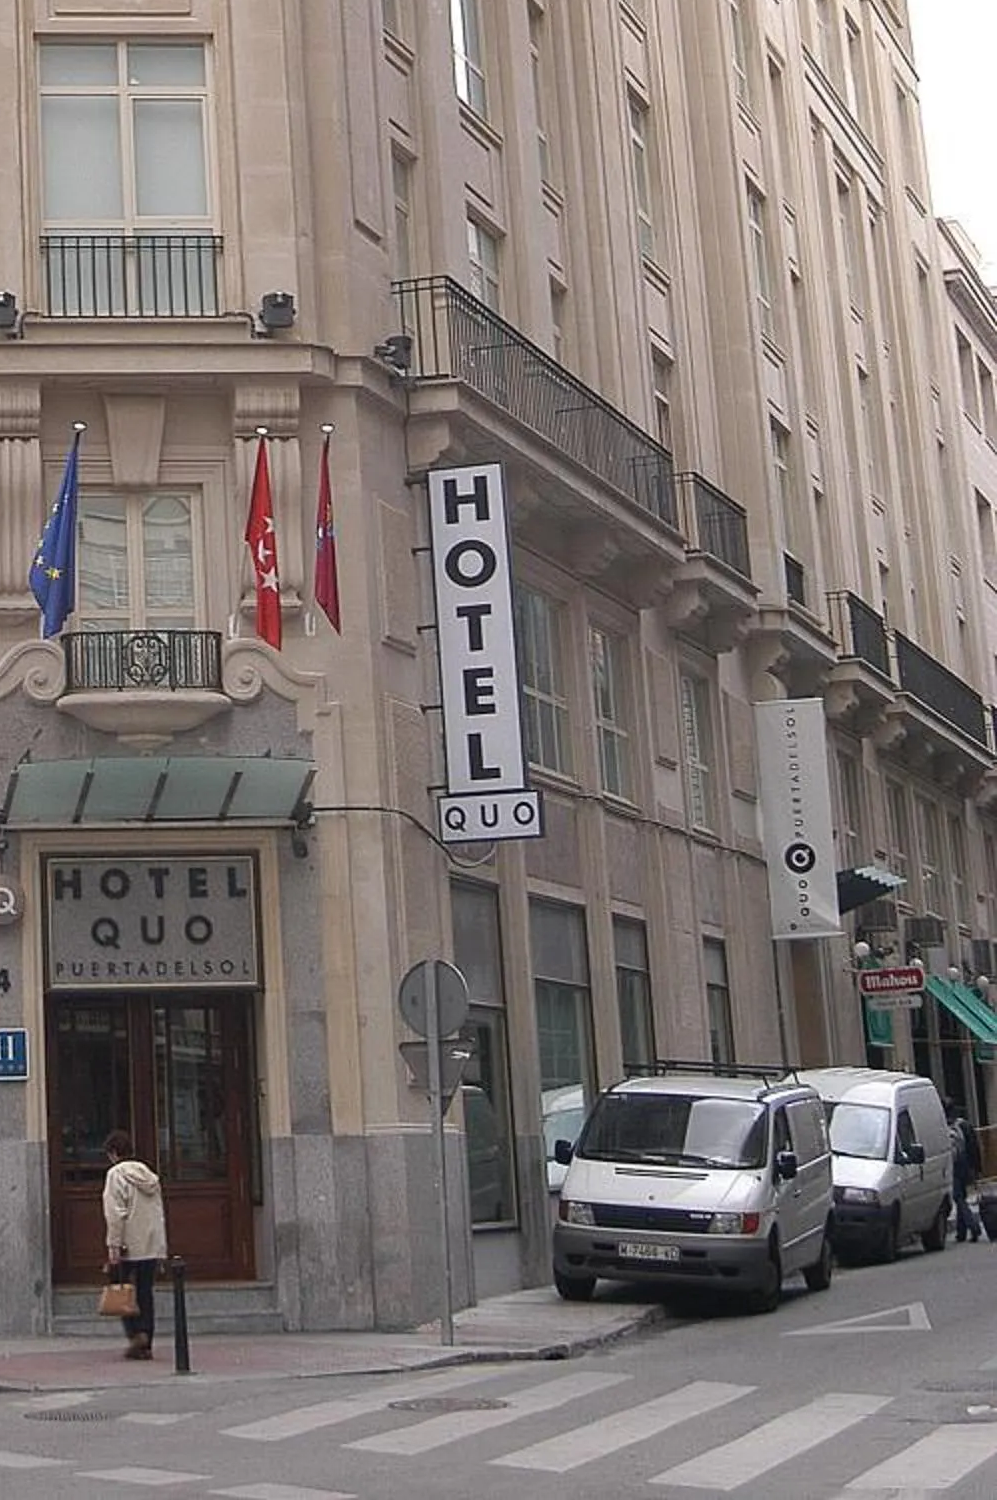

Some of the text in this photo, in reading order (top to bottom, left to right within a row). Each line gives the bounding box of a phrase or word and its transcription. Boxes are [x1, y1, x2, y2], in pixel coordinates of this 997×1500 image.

[442, 475, 502, 781] HOTEL
[444, 801, 535, 832] QUO
[53, 867, 247, 900] HOTEL
[798, 879, 811, 917] QUO
[90, 915, 214, 949] QUO
[56, 959, 250, 977] PUERTADELSOL
[865, 972, 919, 990] Mahou
